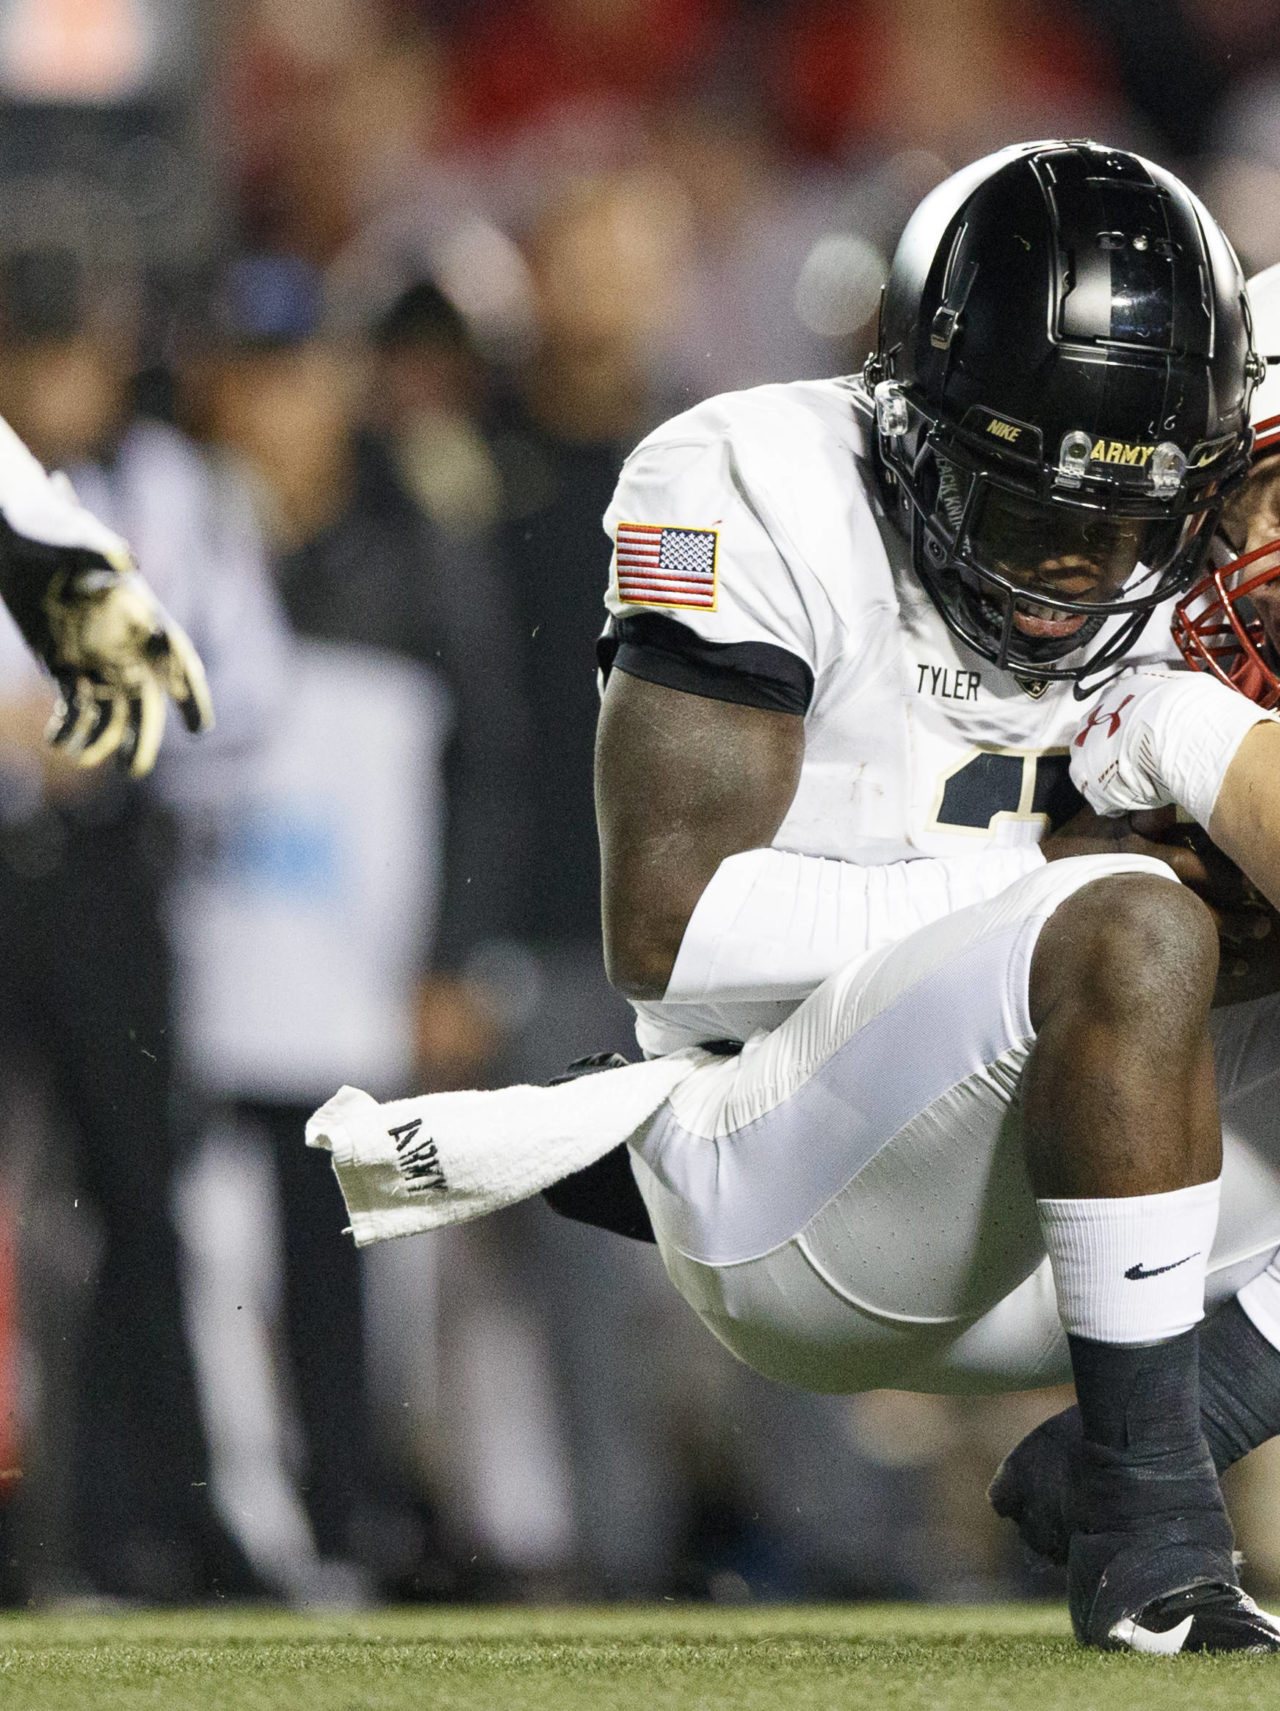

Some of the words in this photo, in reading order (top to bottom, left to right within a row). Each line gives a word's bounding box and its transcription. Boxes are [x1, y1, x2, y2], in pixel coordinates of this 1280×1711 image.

[986, 418, 1022, 443] NIKE
[1089, 439, 1155, 467] ARMY
[935, 452, 959, 495] LACK
[916, 663, 982, 702] TYLER
[387, 1117, 449, 1194] ARMY
